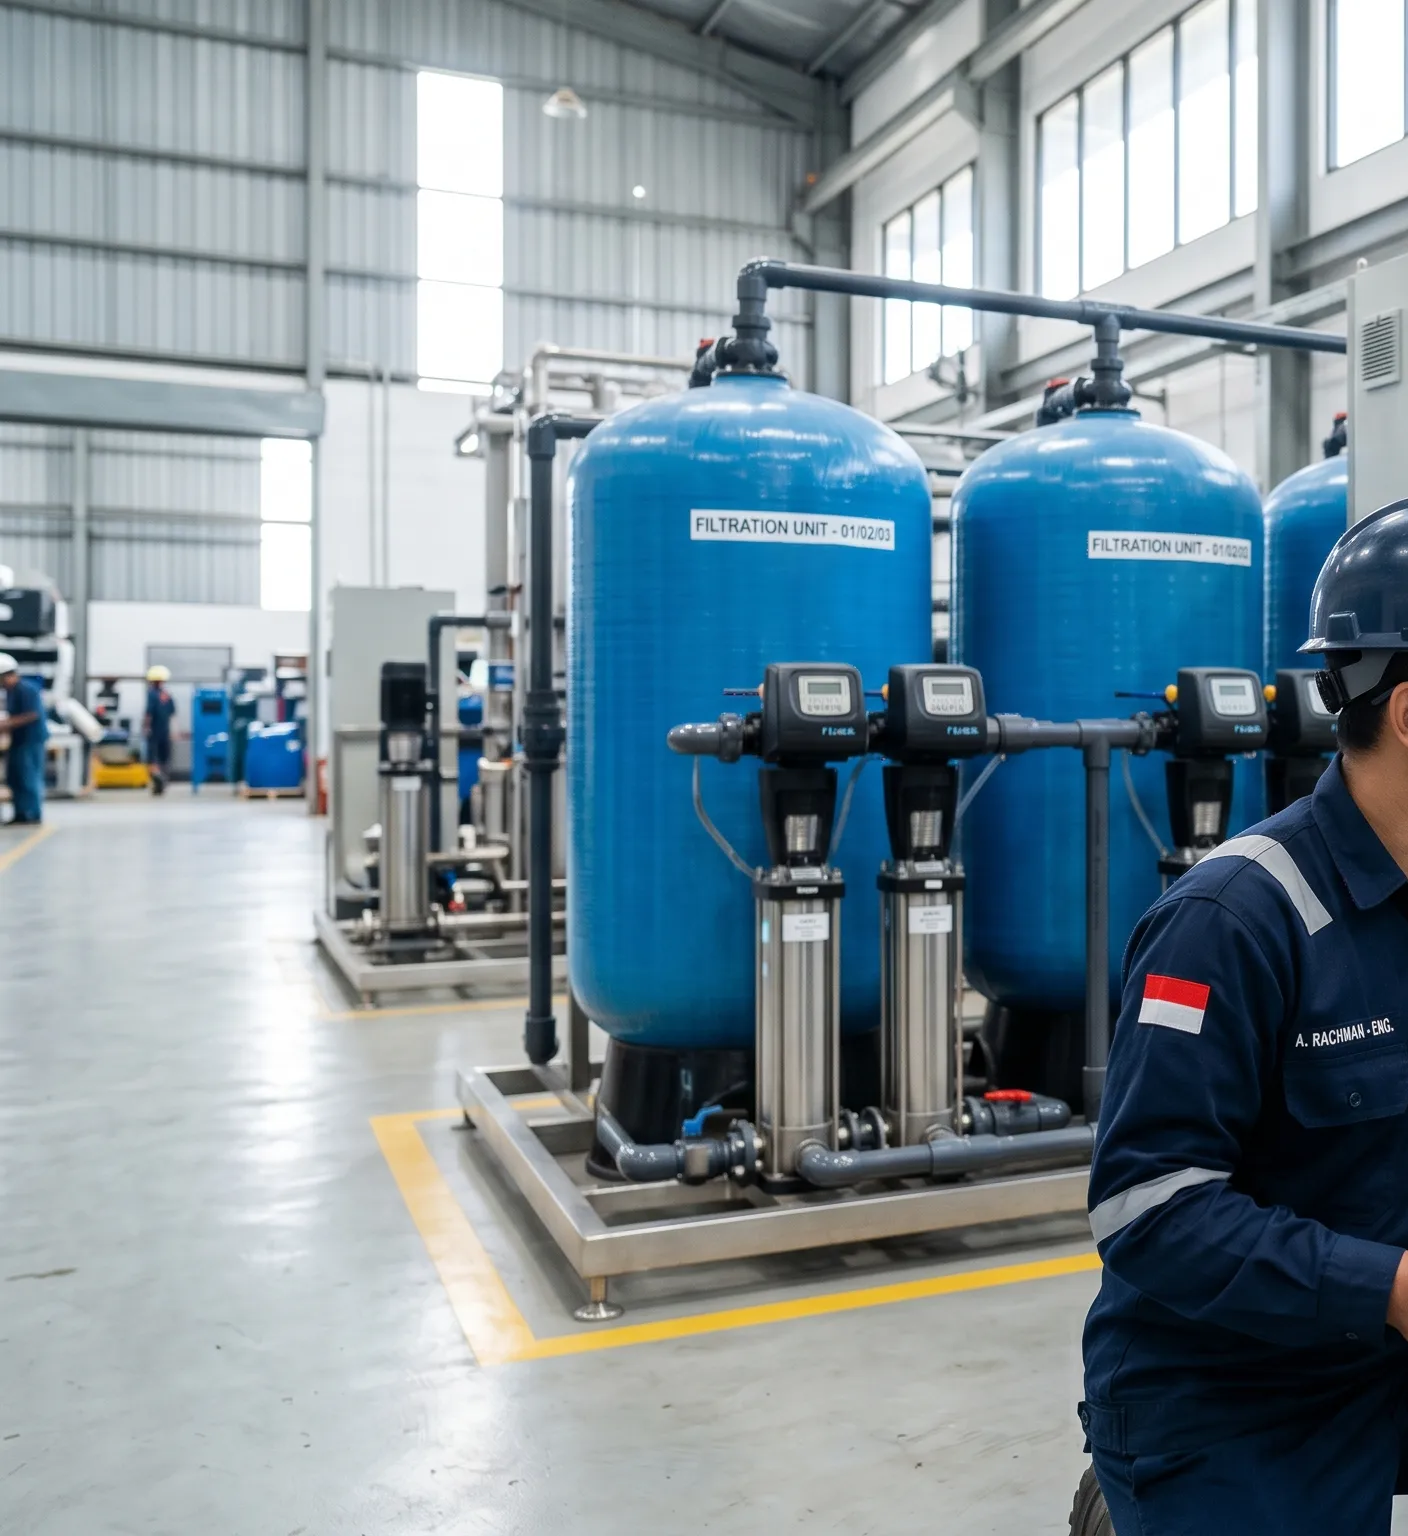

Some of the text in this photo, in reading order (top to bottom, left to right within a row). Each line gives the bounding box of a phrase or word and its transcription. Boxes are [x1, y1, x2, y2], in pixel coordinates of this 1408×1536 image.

[695, 517, 789, 536] FILTRATION
[793, 520, 828, 537] UNIT
[840, 524, 891, 542] 01/02/03
[1092, 538, 1171, 553] FILTRATION
[1174, 540, 1203, 554] UNIT
[1294, 1033, 1308, 1048] A.
[1312, 1023, 1366, 1047] RACHMAN
[1371, 1018, 1395, 1036] ENG.
